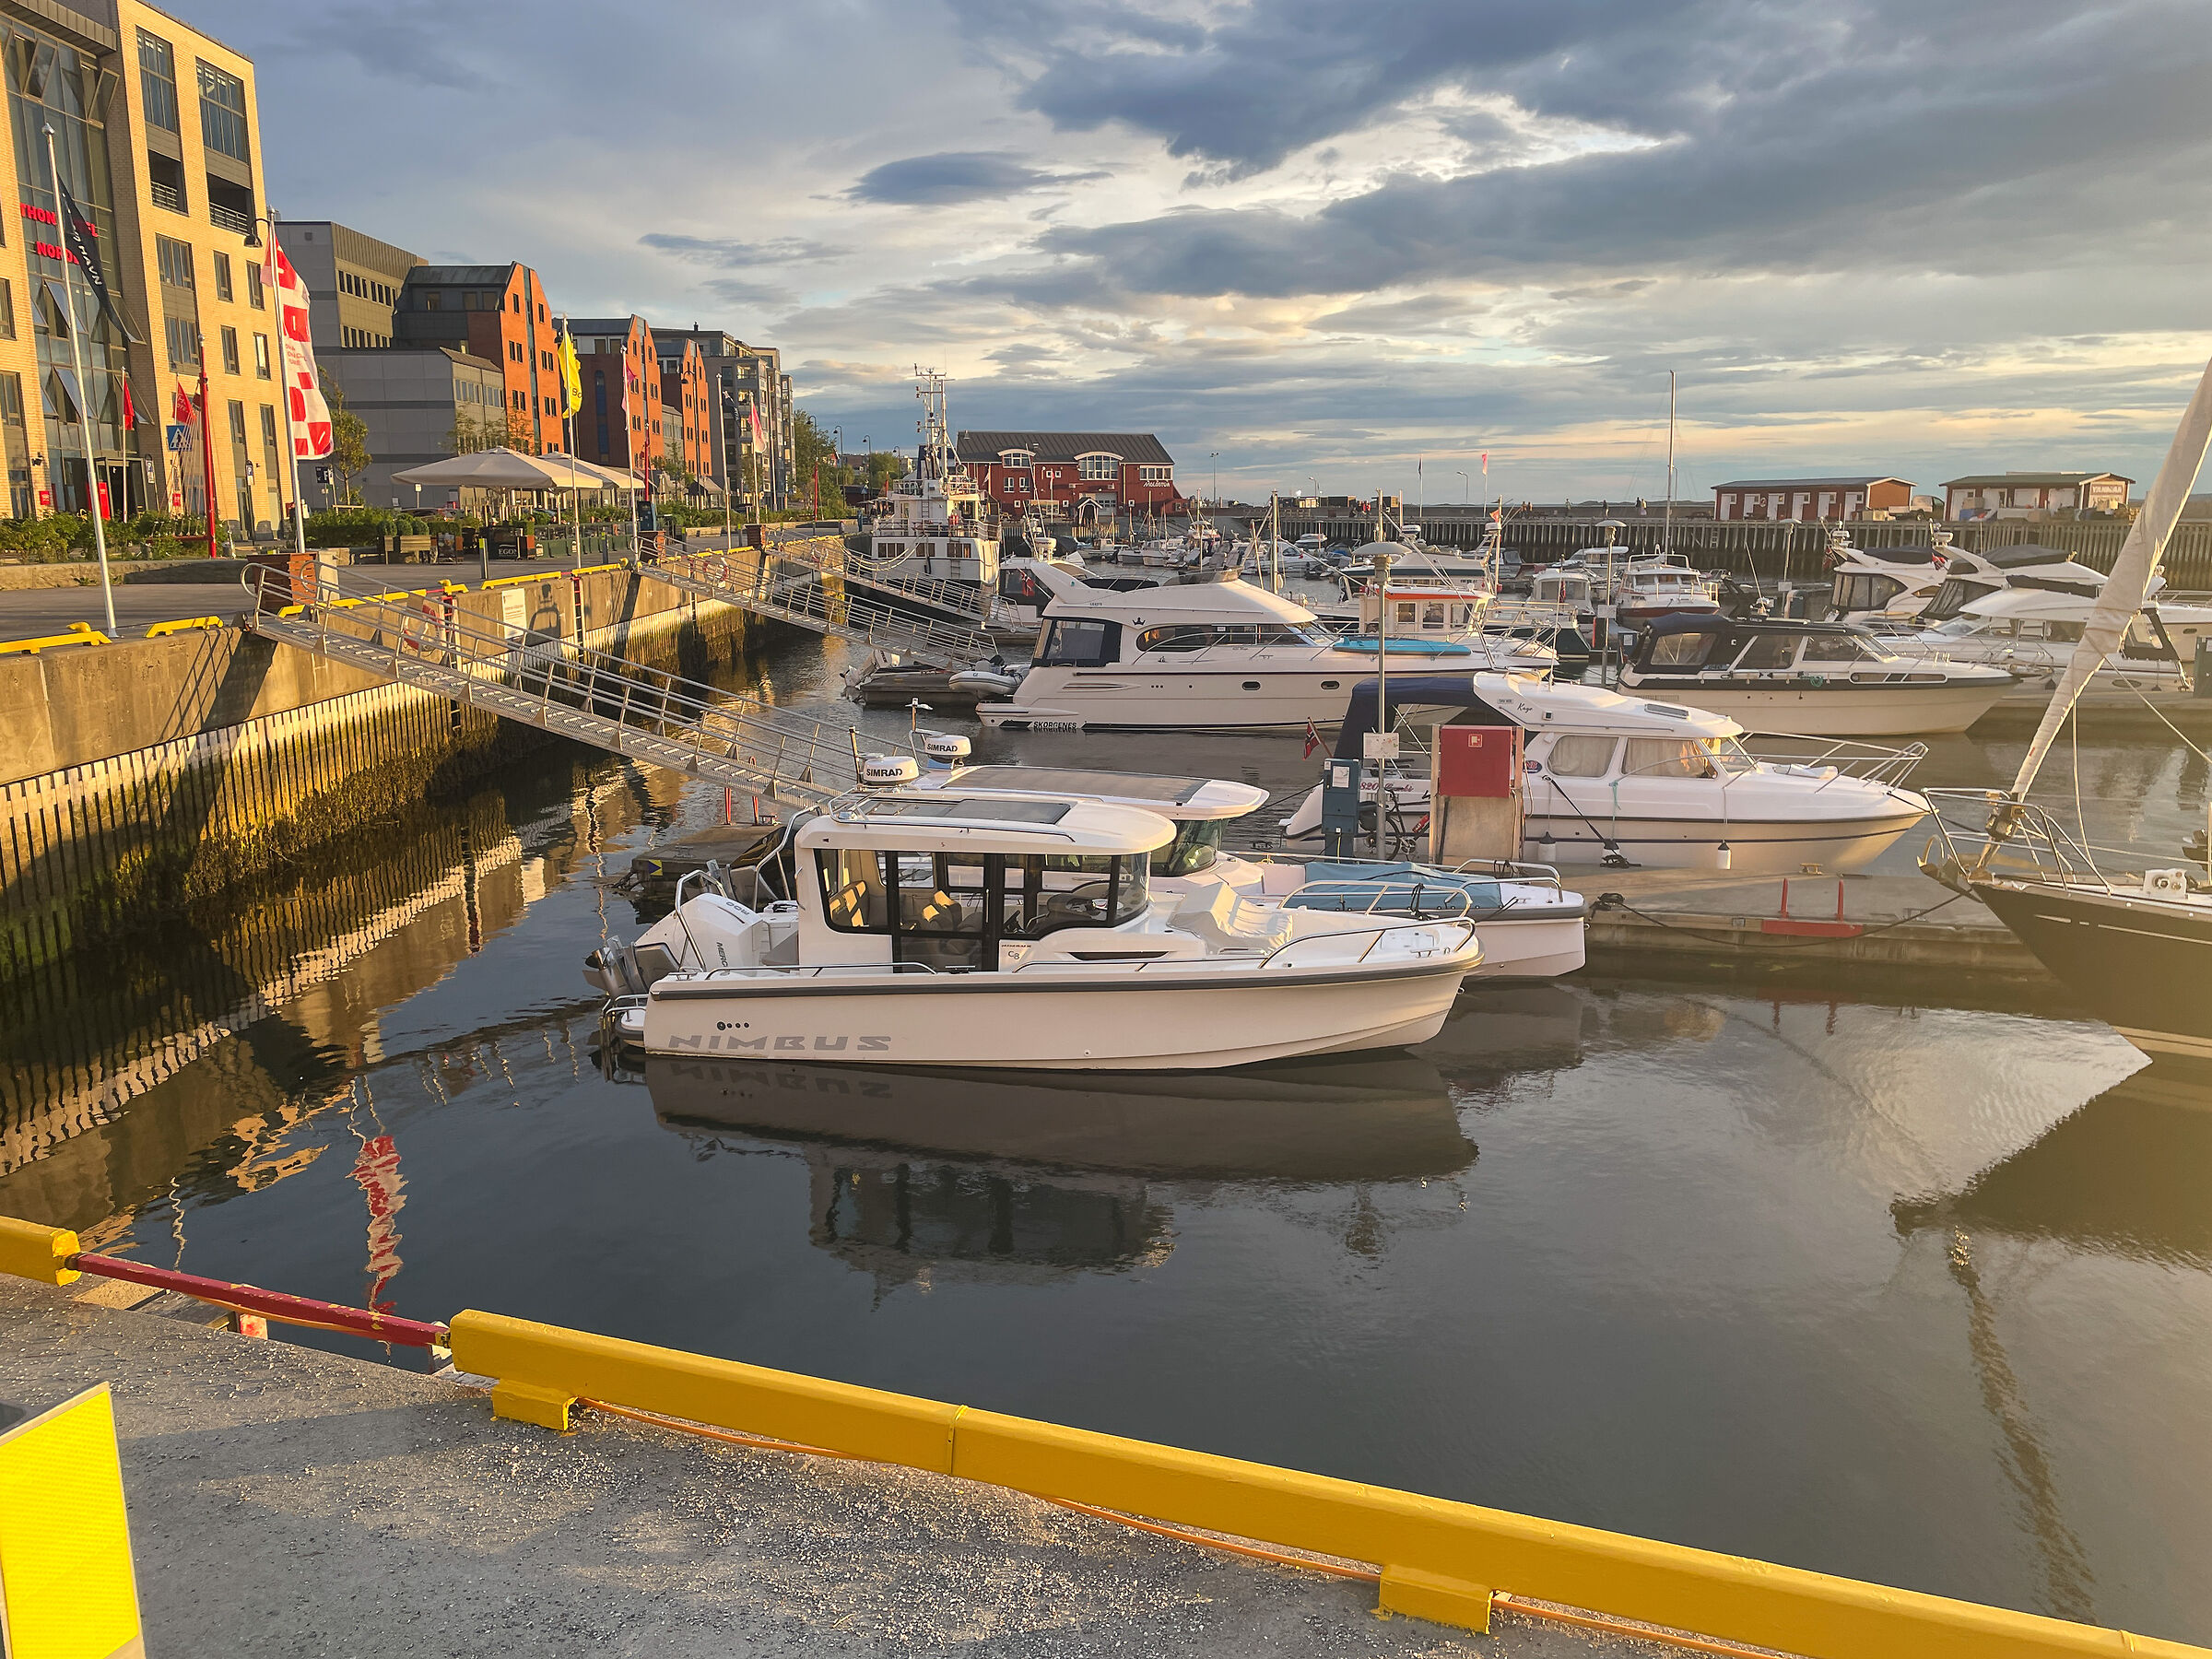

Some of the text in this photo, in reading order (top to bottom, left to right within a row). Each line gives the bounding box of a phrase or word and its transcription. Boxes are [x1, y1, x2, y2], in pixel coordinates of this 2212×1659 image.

[19, 202, 57, 226] THON
[77, 245, 102, 285] HAVN
[1033, 721, 1077, 729] SKORGENES
[926, 743, 958, 752] SIMRAD
[866, 768, 903, 777] SIMRAD
[1360, 782, 1379, 791] 820
[668, 1035, 891, 1051] NIMBUS
